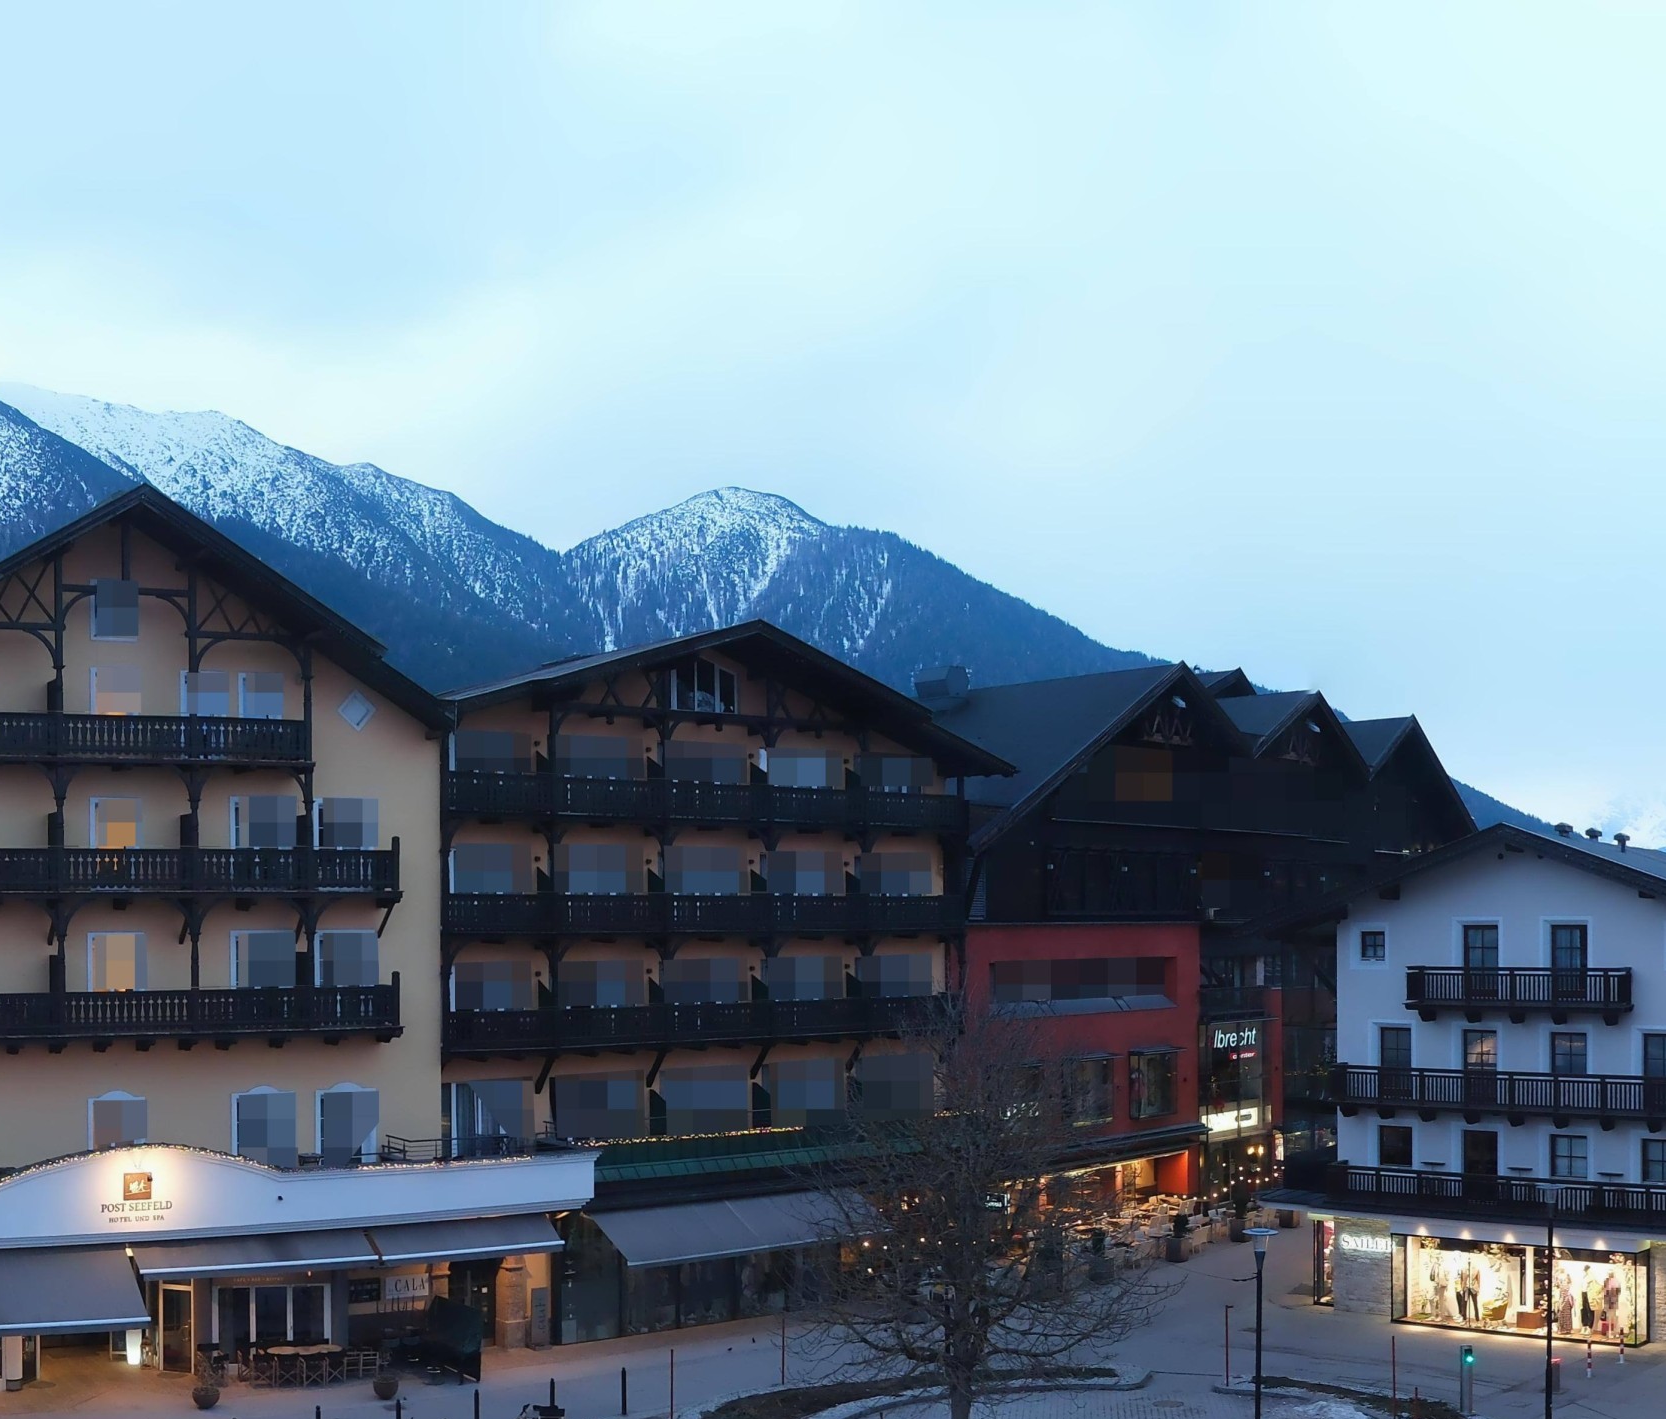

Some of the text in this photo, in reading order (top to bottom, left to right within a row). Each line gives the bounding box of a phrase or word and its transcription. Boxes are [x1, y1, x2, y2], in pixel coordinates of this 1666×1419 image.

[1232, 1052, 1256, 1060] cnter
[100, 1200, 173, 1213] POST SEEFELD
